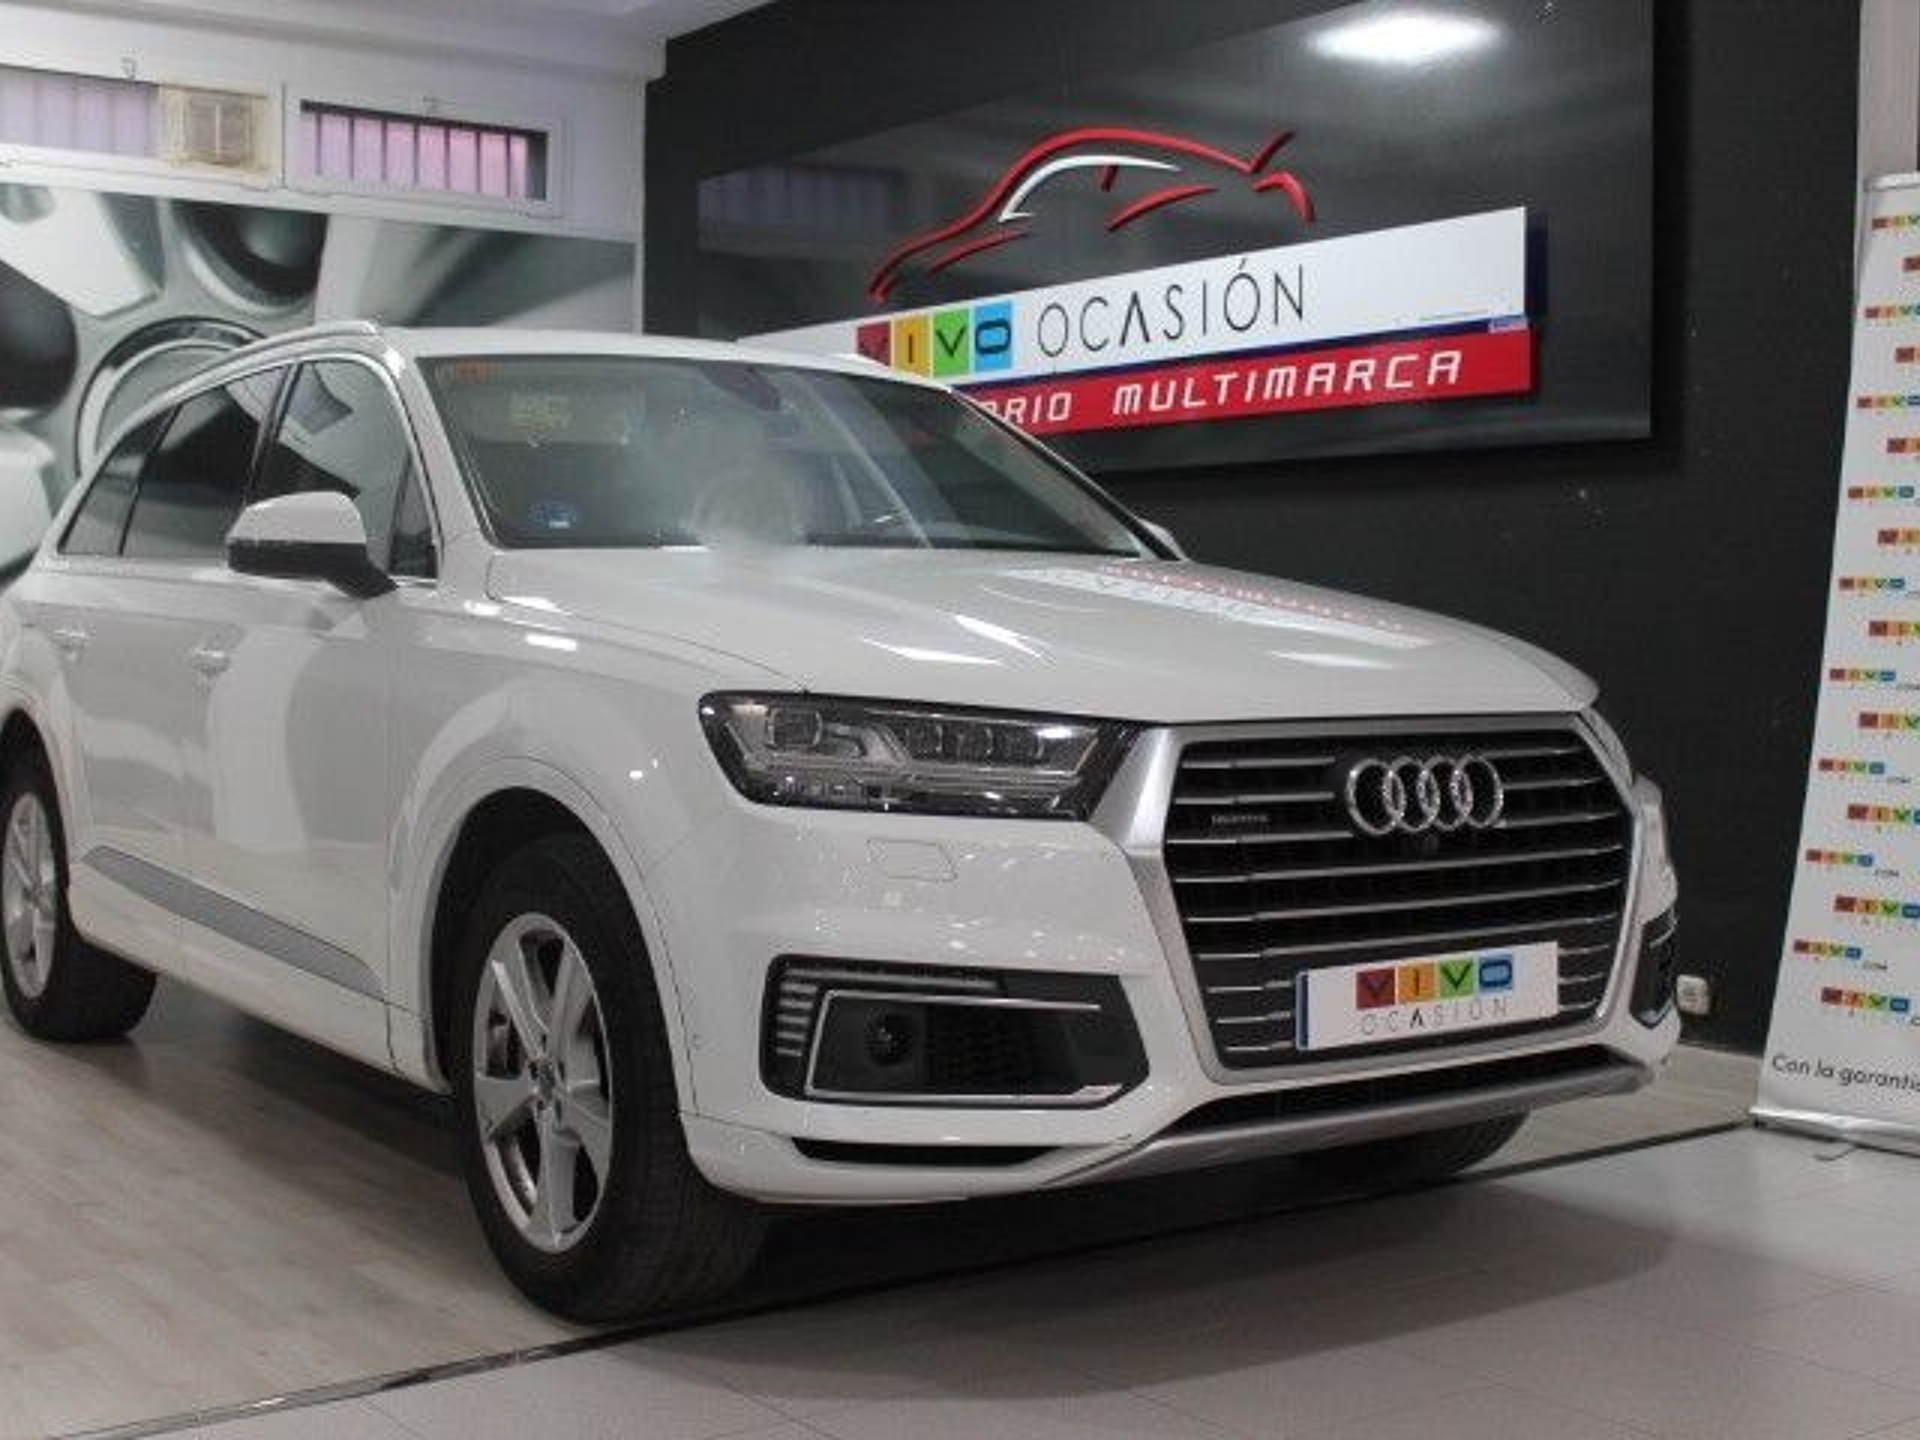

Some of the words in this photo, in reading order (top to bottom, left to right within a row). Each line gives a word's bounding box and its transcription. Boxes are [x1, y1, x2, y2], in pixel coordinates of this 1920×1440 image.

[858, 314, 1012, 370] VIVO
[1038, 257, 1303, 357] OCASIÓN
[1112, 350, 1462, 416] MULTIMARCA
[1359, 955, 1513, 1006] VIVO
